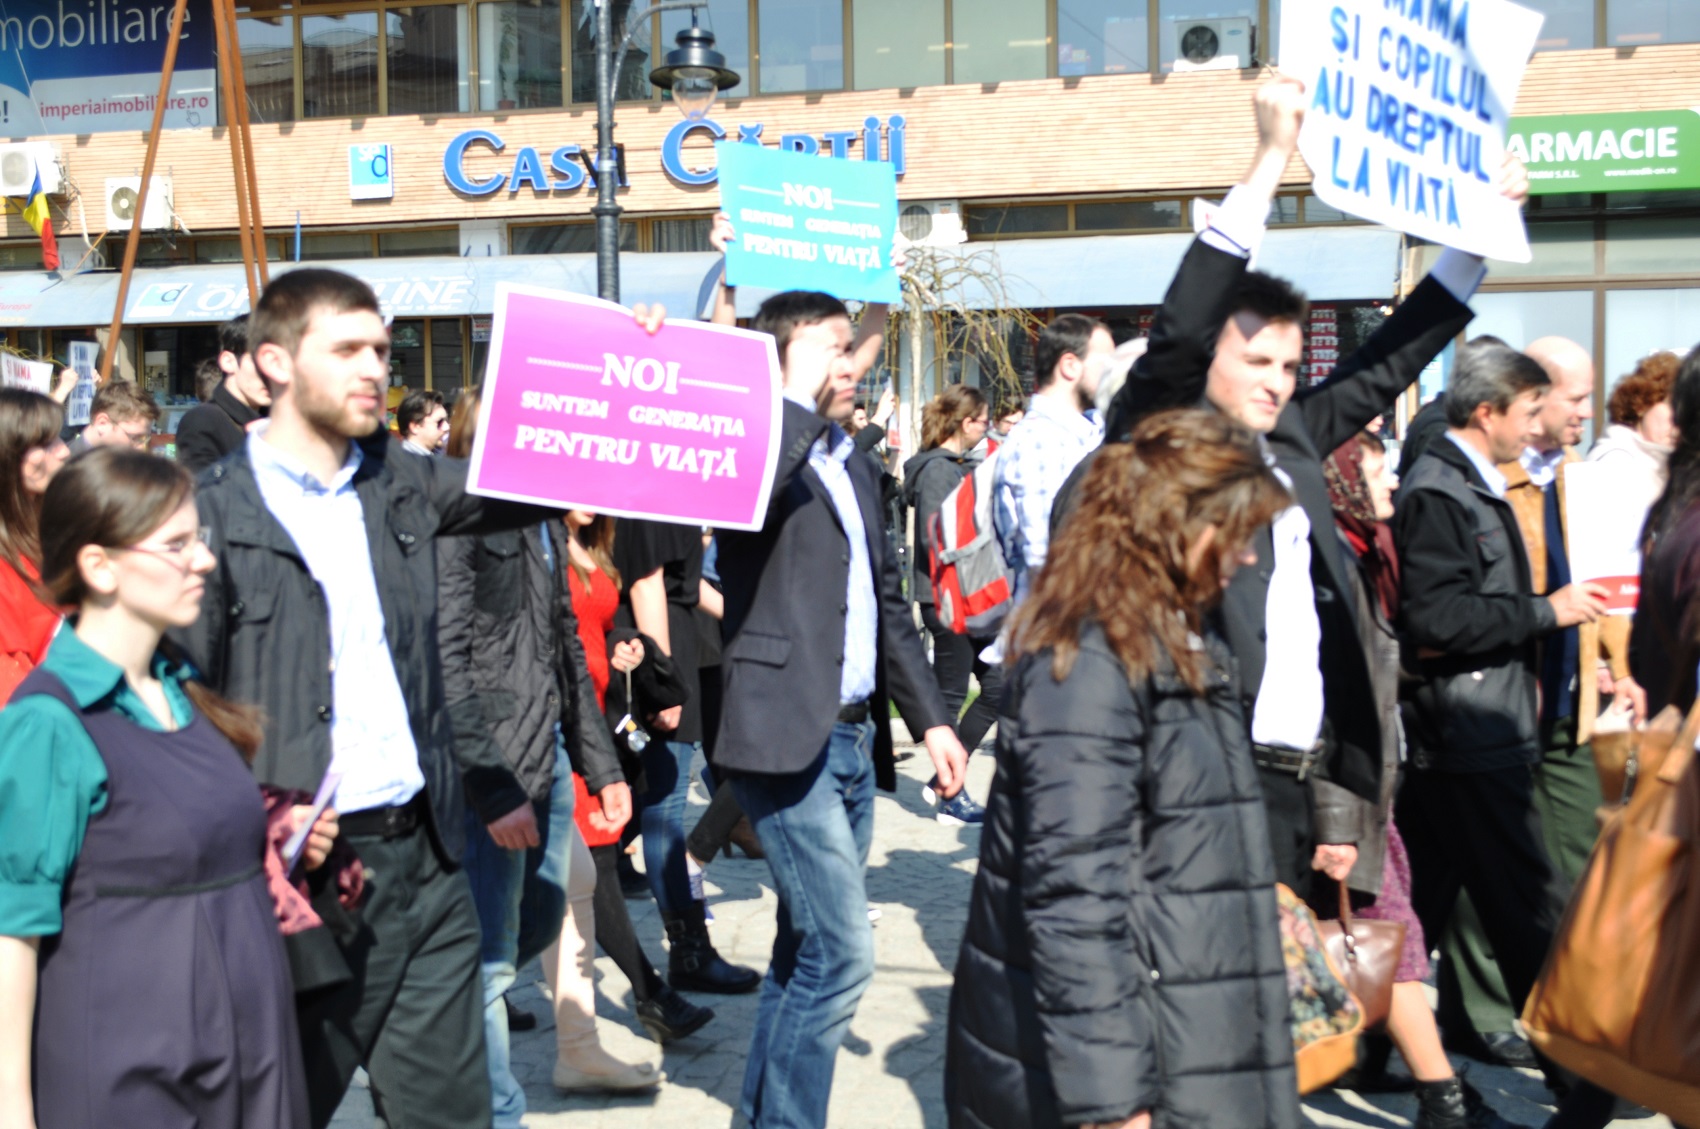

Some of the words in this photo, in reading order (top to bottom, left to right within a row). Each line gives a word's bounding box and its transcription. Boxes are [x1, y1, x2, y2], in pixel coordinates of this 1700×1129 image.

[1378, 26, 1491, 124] COPILUL
[40, 96, 209, 120] imperiaimobilre.ro
[1312, 66, 1354, 120] AU
[1366, 84, 1490, 183] DREPTUL
[1332, 135, 1371, 197] LA
[782, 182, 834, 211] NOI
[743, 232, 818, 262] PENTRU
[601, 353, 681, 394] NOI
[521, 390, 609, 419] SUNTEM
[628, 404, 746, 438] GENERAȚIA
[514, 424, 640, 465] PENTRU
